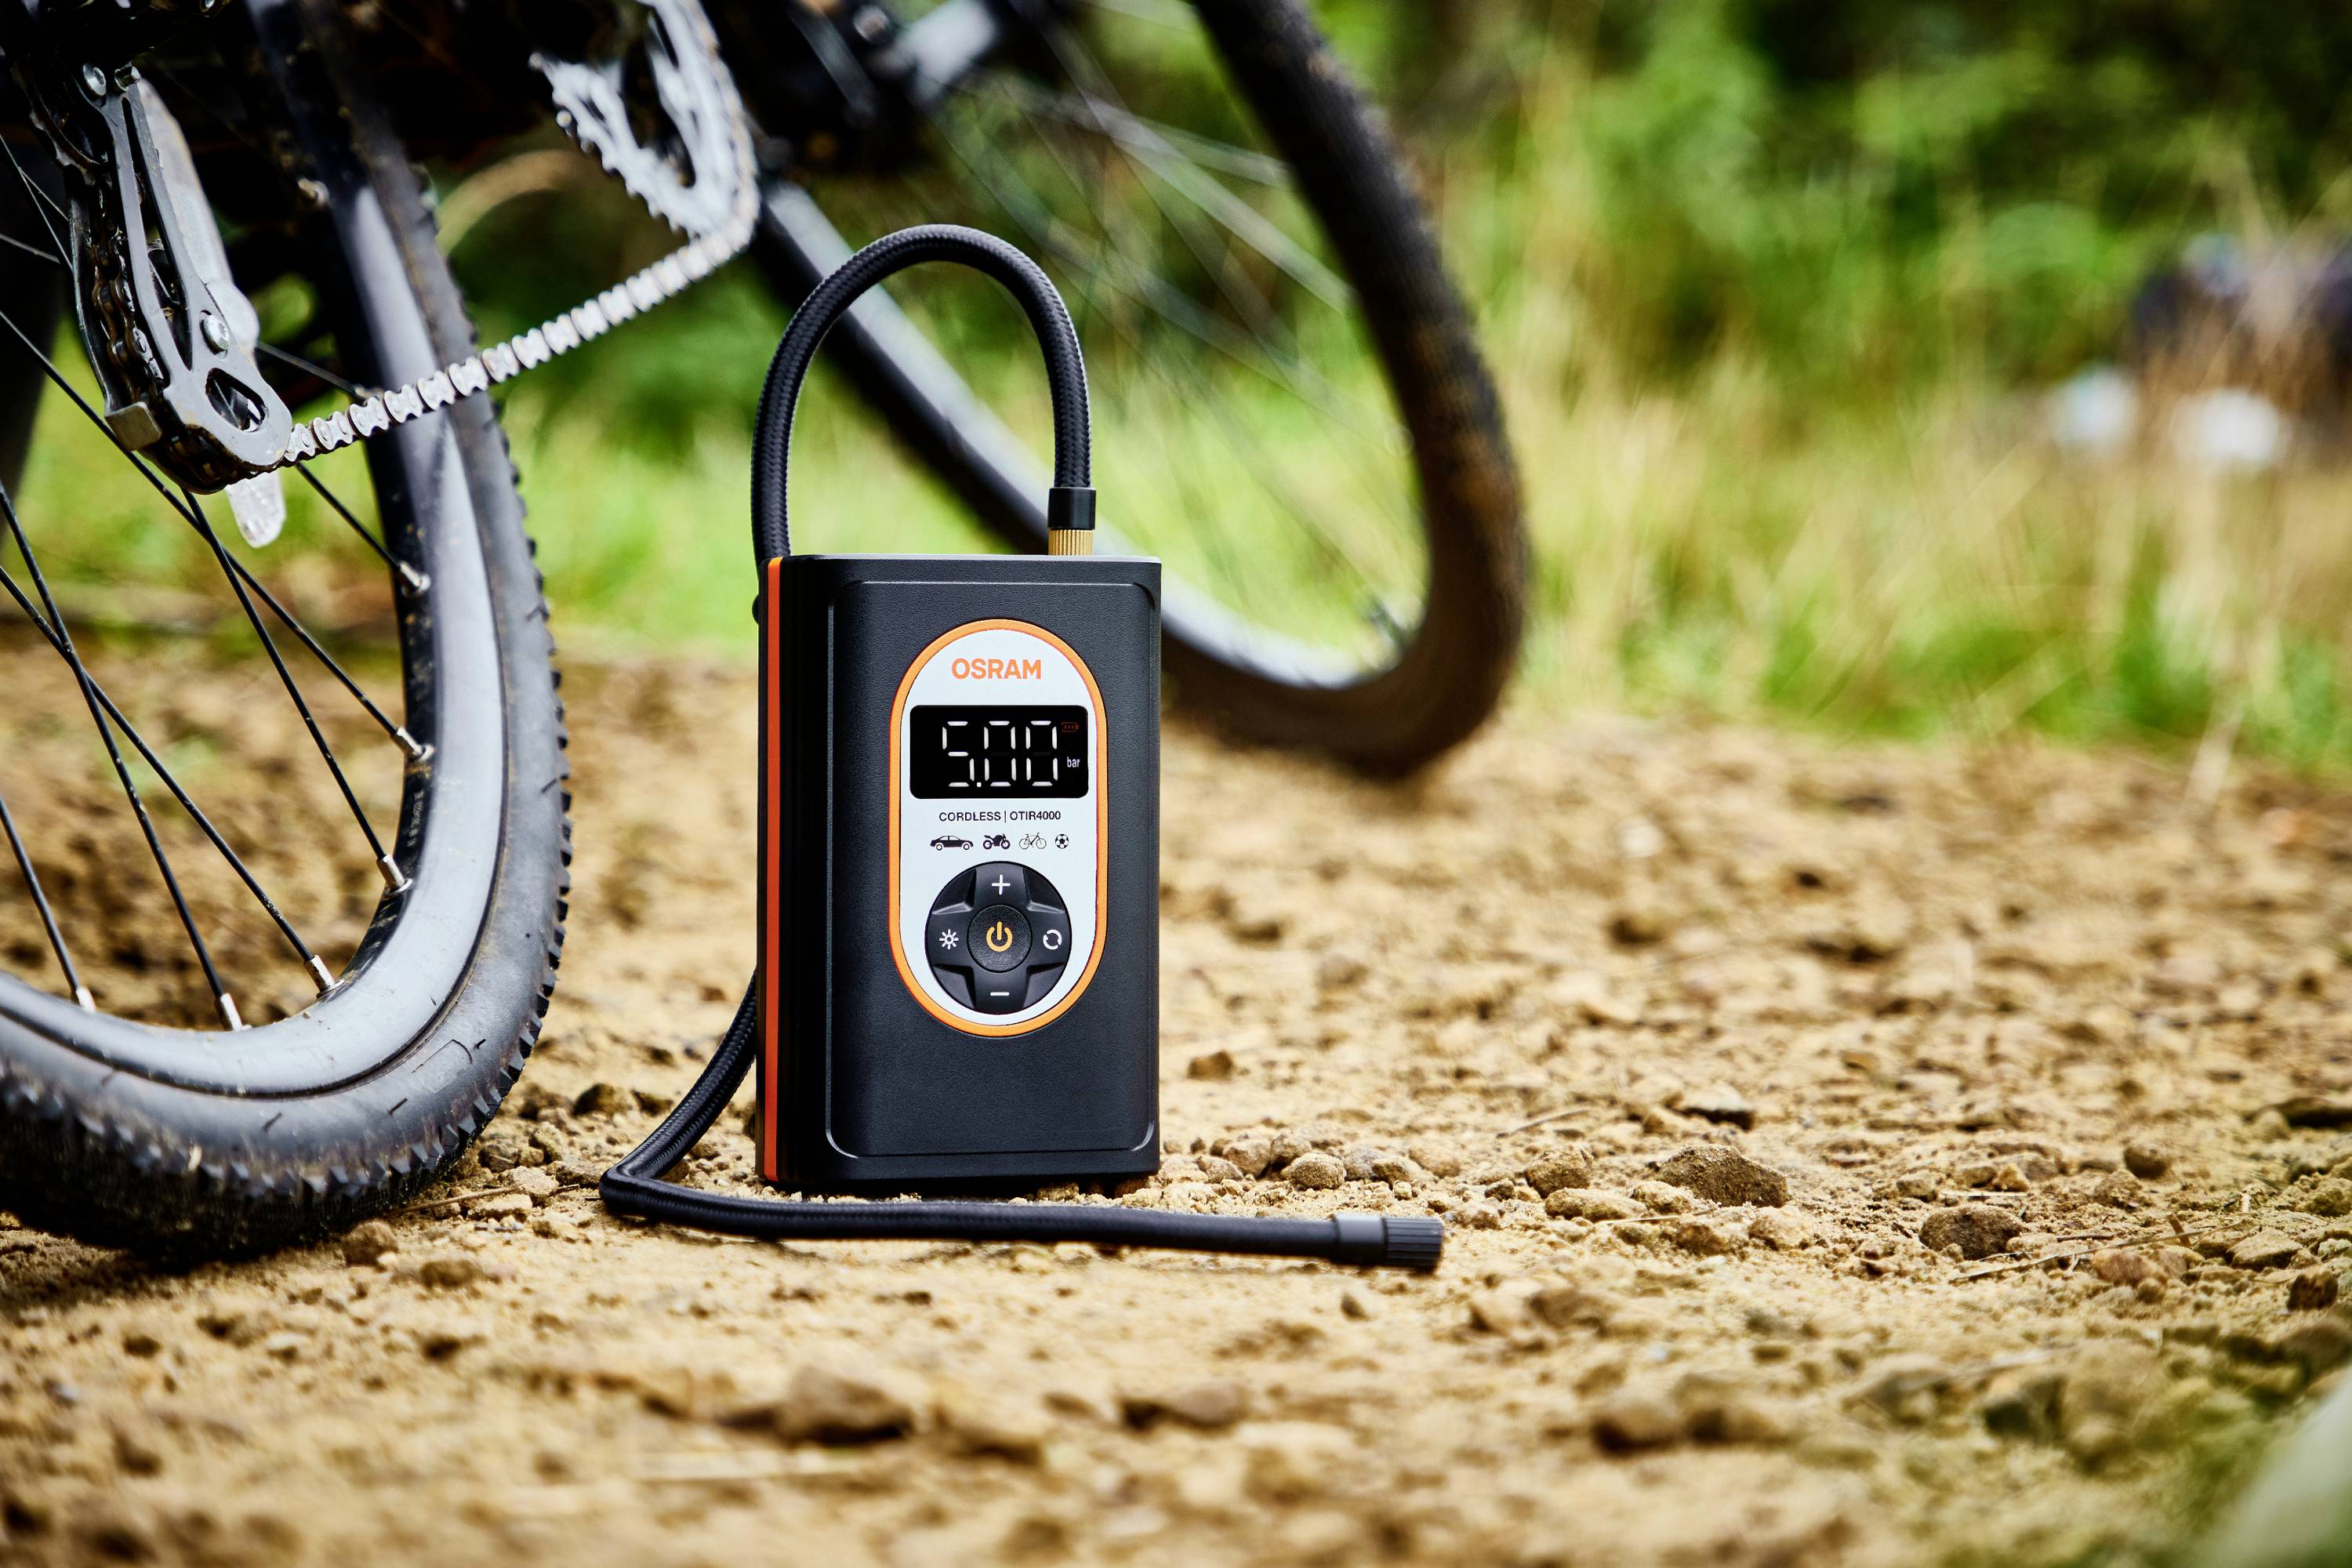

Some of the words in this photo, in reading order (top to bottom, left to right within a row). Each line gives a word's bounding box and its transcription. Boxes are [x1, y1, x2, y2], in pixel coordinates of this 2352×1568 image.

[951, 658, 1042, 680] OSRAM
[942, 720, 1058, 787] 5.00
[1066, 757, 1080, 768] bar
[938, 811, 1001, 822] CORDLESS
[1009, 811, 1062, 821] OTIR4000
